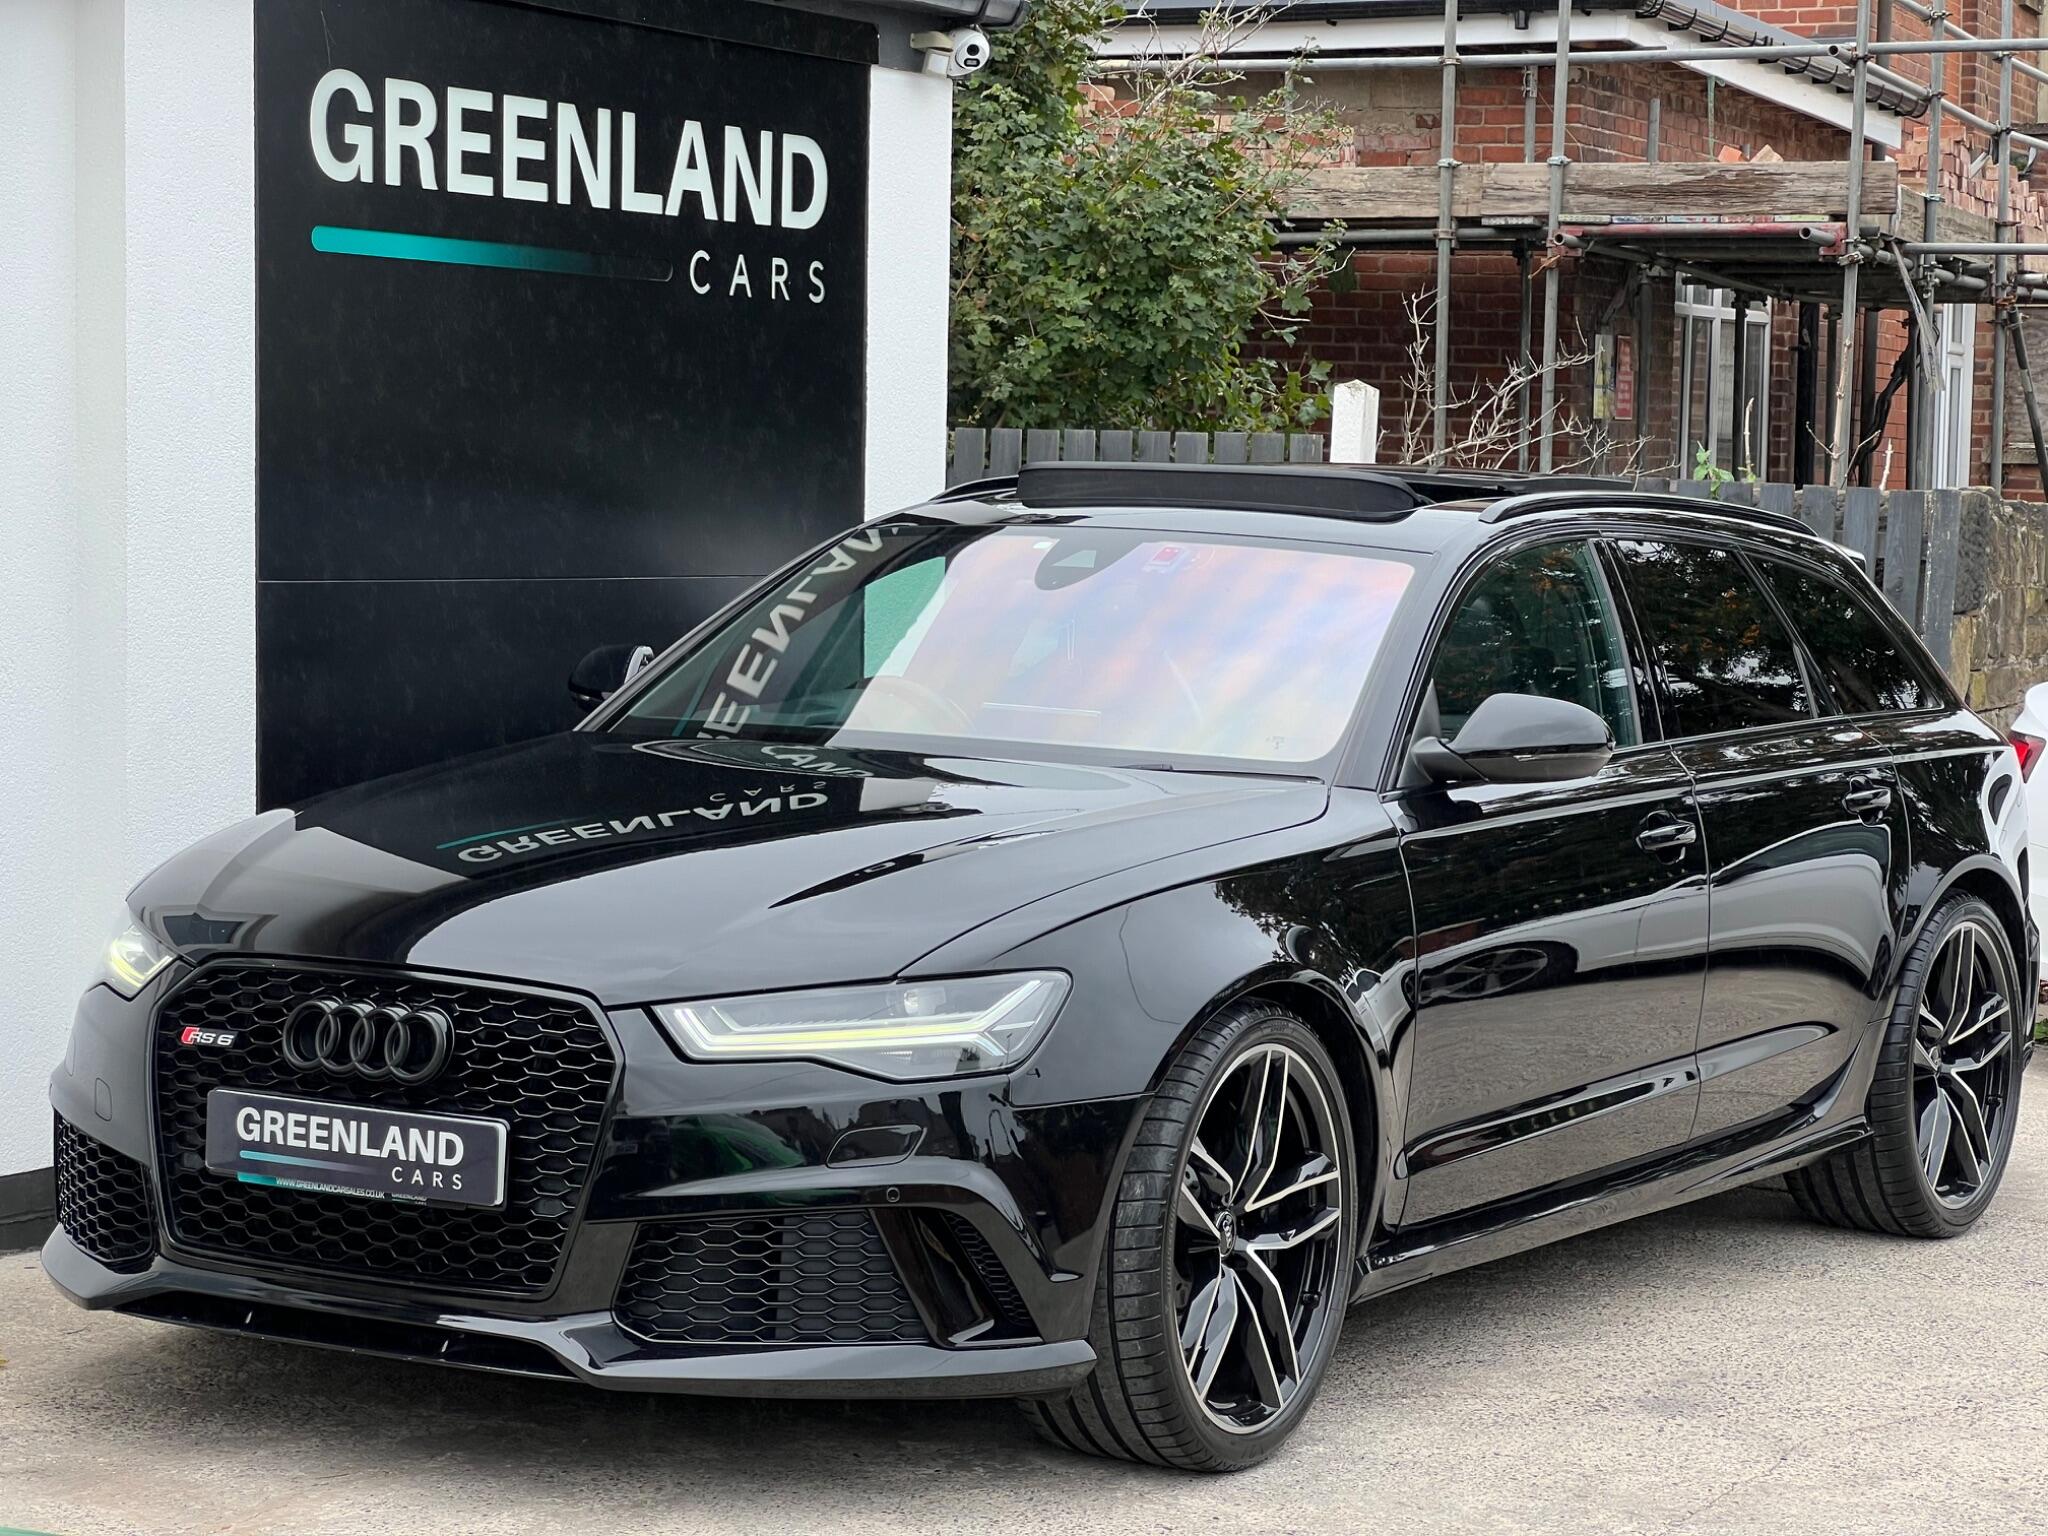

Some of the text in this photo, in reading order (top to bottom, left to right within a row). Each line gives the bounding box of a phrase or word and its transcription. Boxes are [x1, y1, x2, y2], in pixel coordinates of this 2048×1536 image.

[309, 67, 829, 231] GREENLAND
[689, 249, 827, 304] CARS
[235, 1106, 465, 1167] GREENLAND
[275, 1177, 386, 1200] WWW.GREENLANDCARSALES.CO.UK
[391, 1166, 463, 1191] CARS
